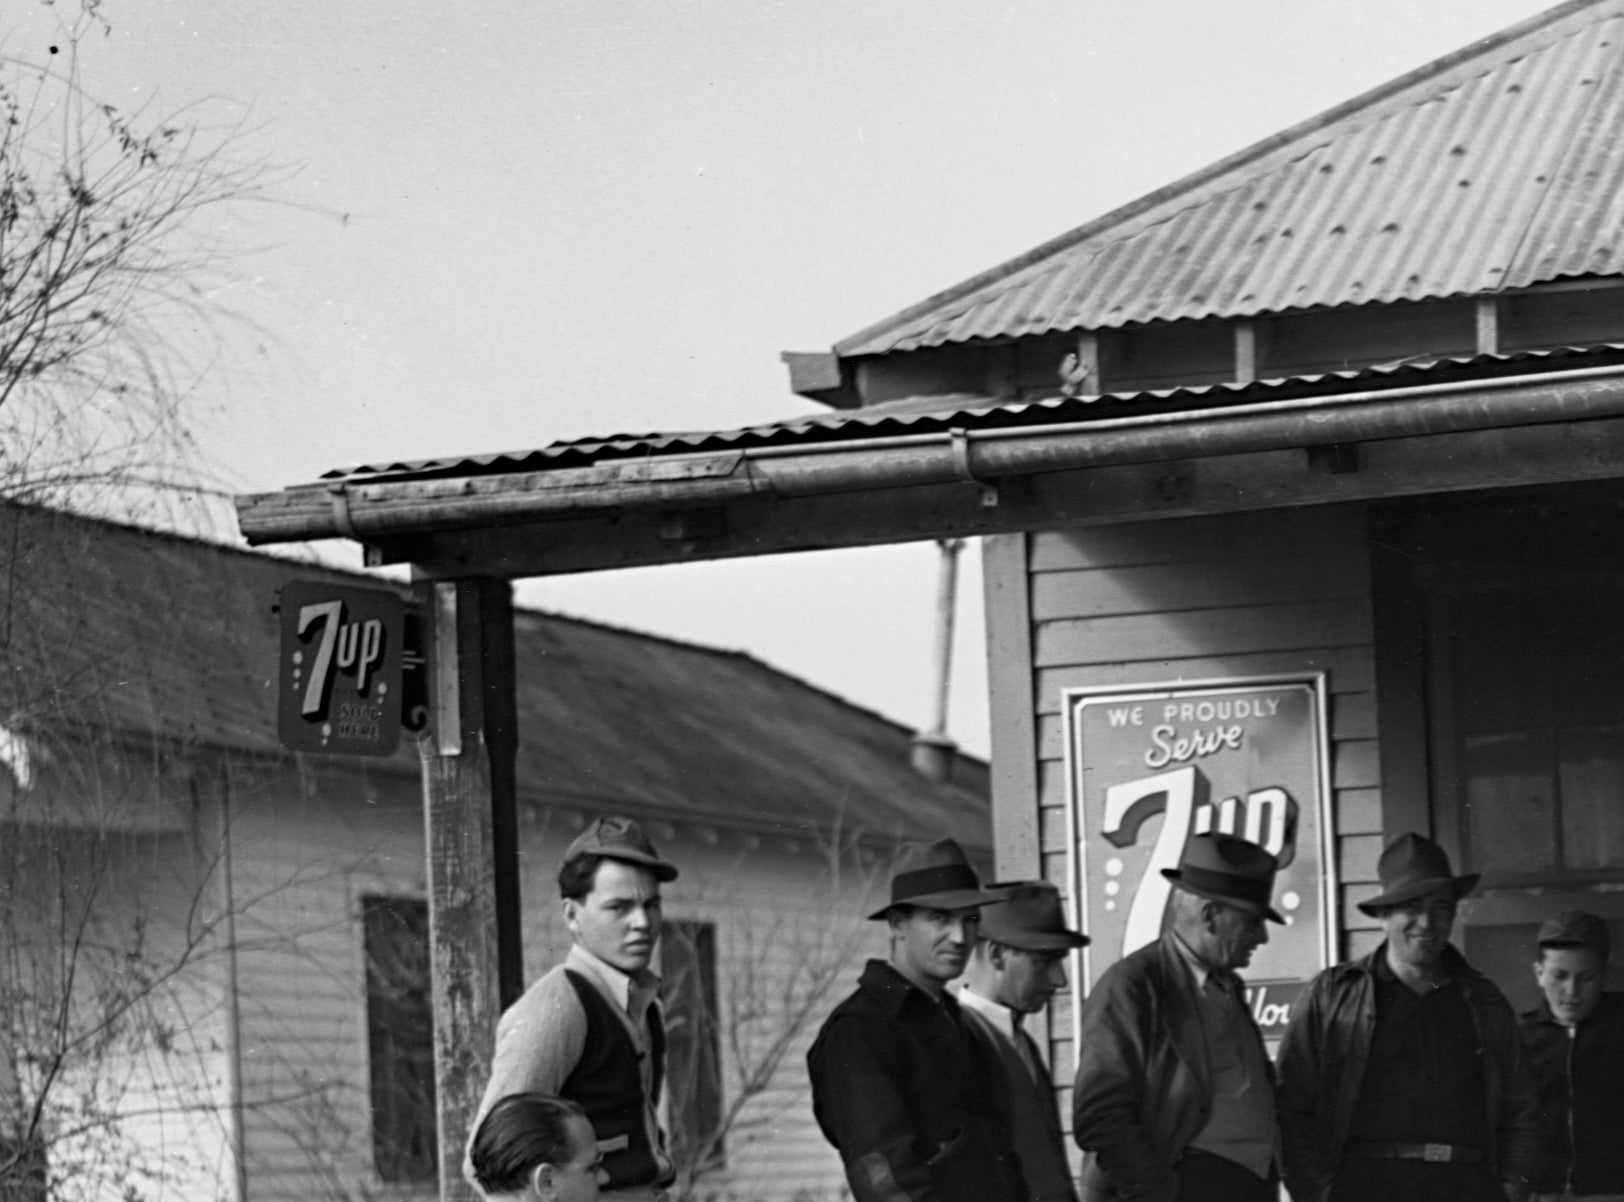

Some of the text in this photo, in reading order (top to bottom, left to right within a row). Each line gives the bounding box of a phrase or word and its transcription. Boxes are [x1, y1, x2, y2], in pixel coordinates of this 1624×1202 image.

[1106, 698, 1280, 728] WE PROUDLY
[1144, 724, 1244, 769] Serve
